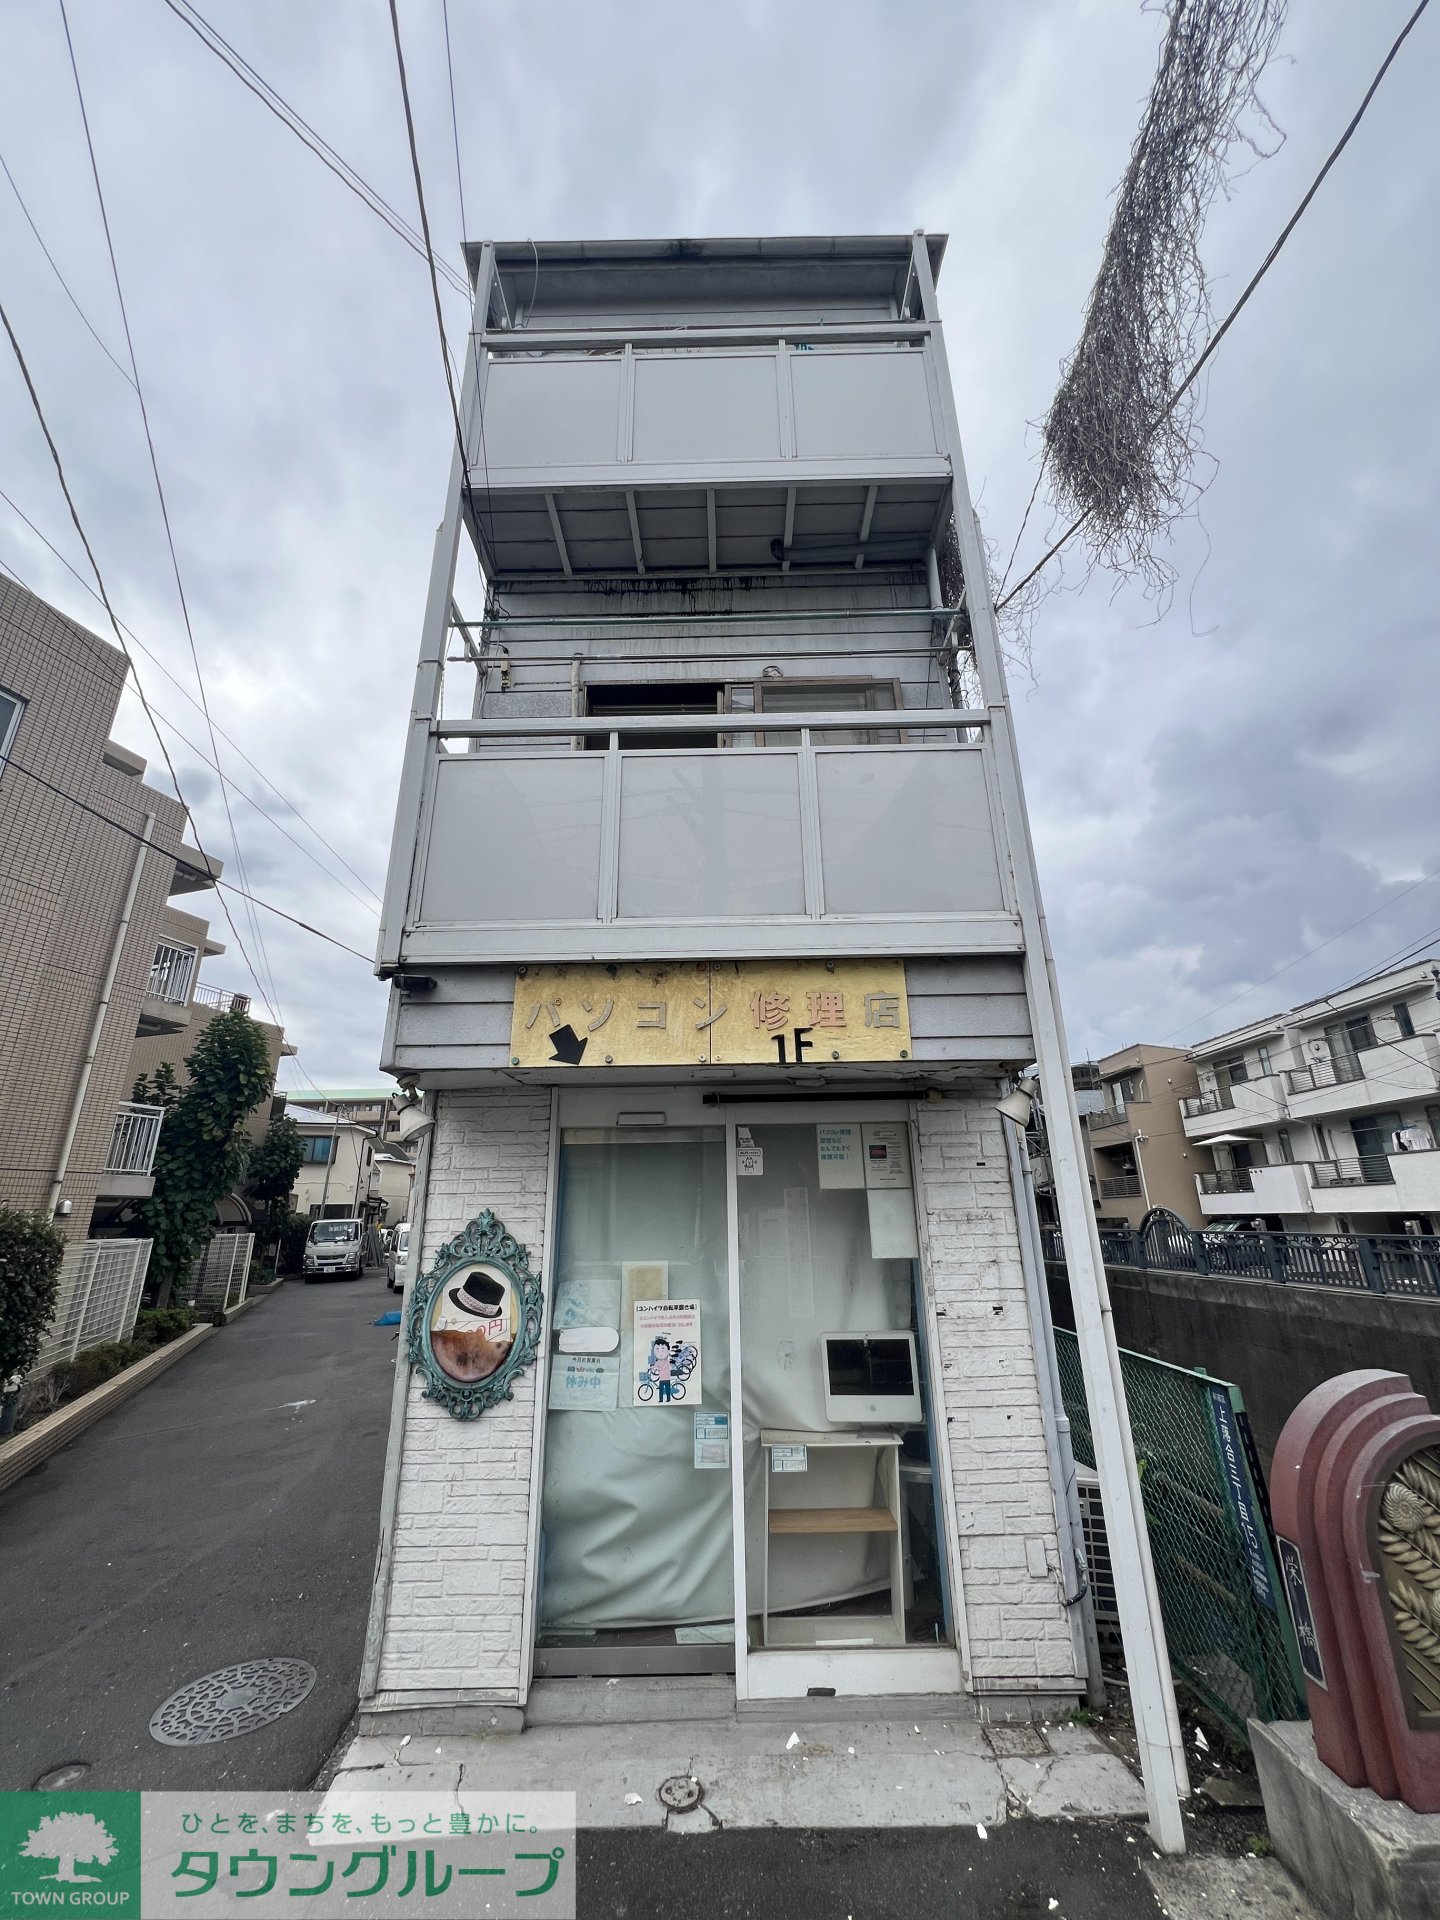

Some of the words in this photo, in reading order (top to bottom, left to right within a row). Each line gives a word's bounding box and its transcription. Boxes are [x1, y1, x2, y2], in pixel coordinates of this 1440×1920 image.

[525, 990, 901, 1031] パソコン修理店
[770, 1027, 814, 1064] 1F
